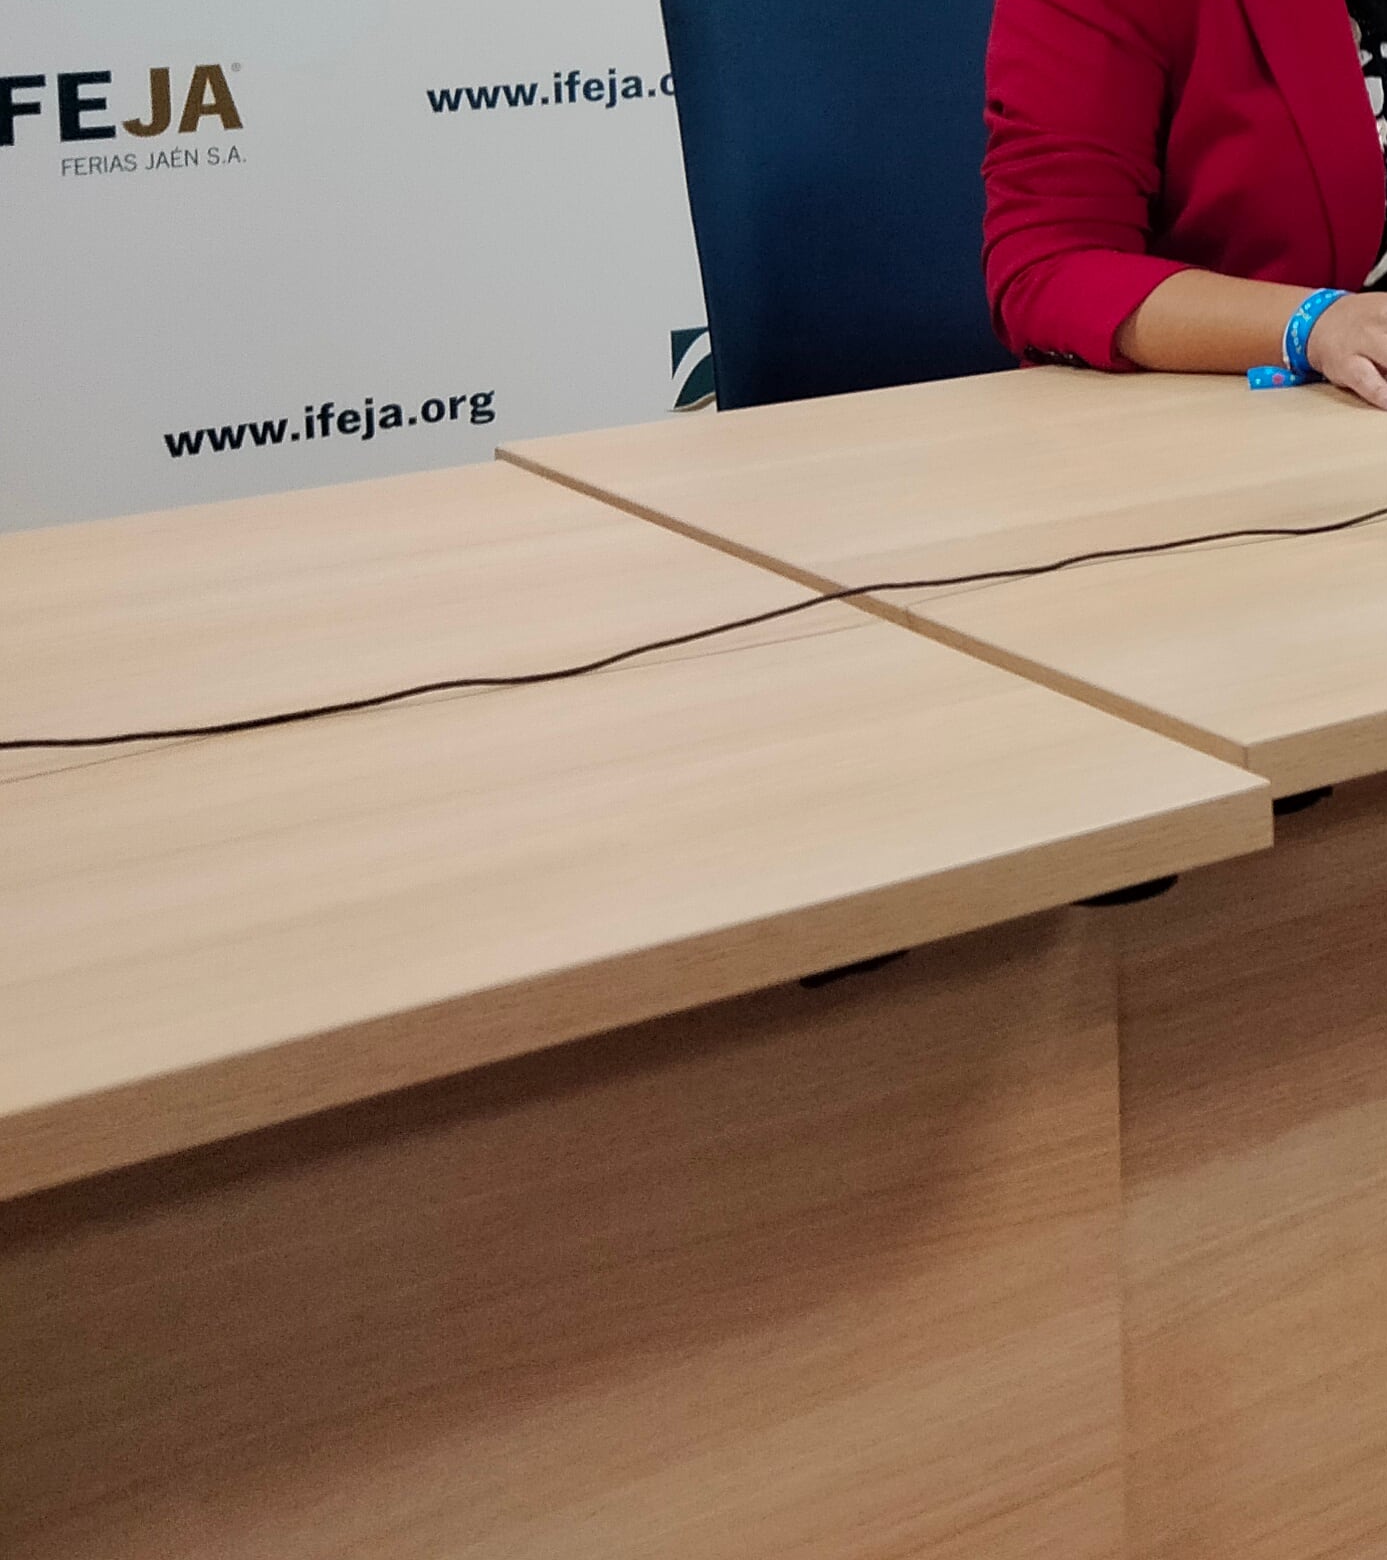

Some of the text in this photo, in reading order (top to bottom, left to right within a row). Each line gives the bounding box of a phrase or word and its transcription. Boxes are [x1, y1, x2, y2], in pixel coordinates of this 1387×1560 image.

[61, 144, 248, 177] FERIAS JAÉN S.A.
[164, 390, 496, 458] www.ifeja.org
